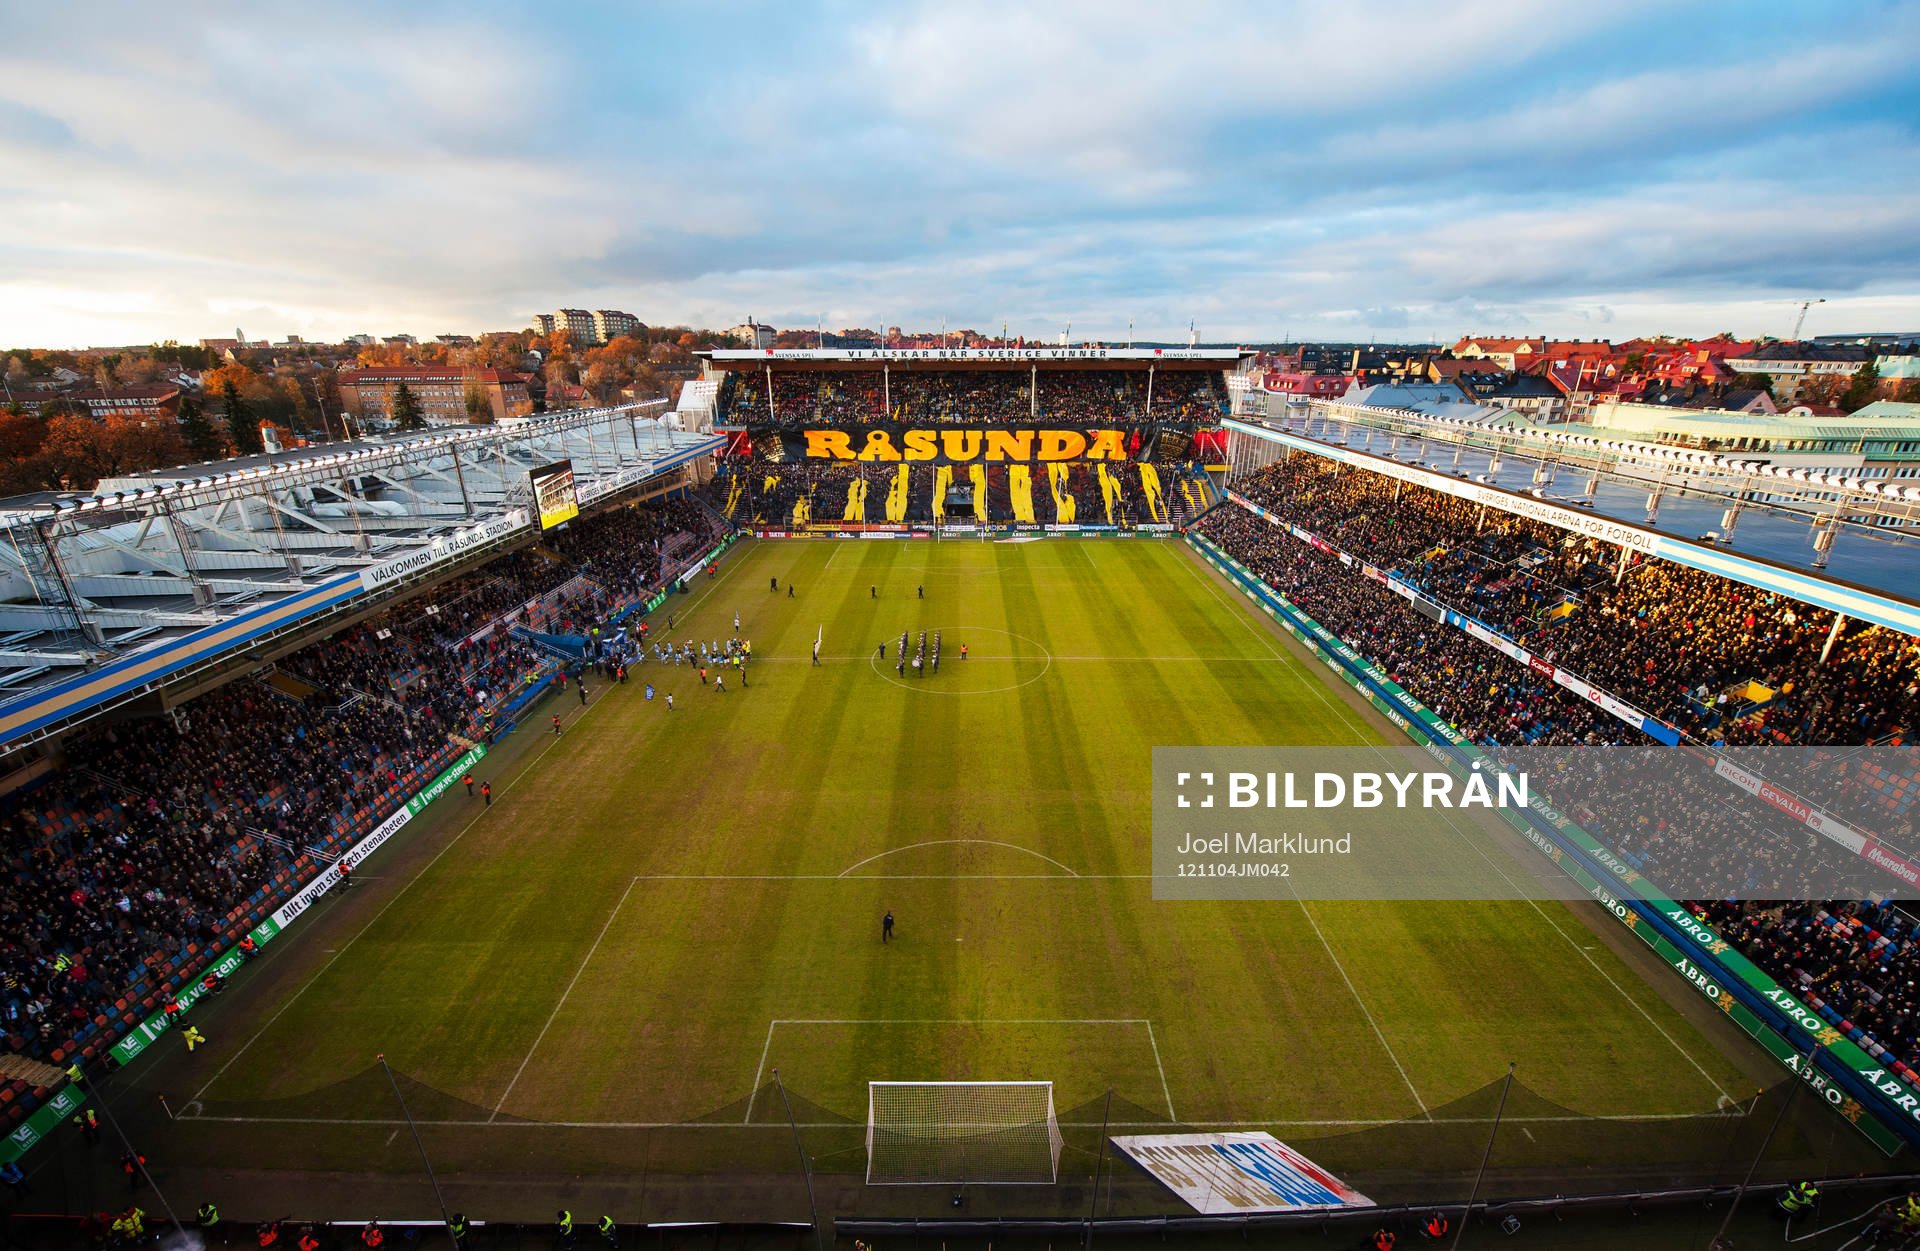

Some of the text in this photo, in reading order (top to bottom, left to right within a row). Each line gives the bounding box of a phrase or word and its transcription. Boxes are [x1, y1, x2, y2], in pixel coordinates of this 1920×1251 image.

[847, 349, 1107, 358] VI ÄLSKAR NÄR SVERIGE VINNER
[803, 429, 1127, 461] RÅSUNDA
[1477, 489, 1652, 550] SVERIGES NATIONALARENA FÖR FOTBOLL
[371, 519, 514, 583] VÄLKOMMEN TILL RÅSUNDA STADION
[1531, 657, 1643, 725] Scandic ICA INTERSPORT
[424, 757, 473, 800] www.ve-sten.se
[1720, 764, 1918, 883] RICOH GEVALIA SVENSKA SPEL Marabou
[282, 899, 302, 921] Allt
[300, 881, 326, 905] inom
[325, 868, 342, 885] ste
[361, 813, 407, 854] stenarbeten
[1431, 720, 1456, 740] ÅBRO
[1589, 847, 1627, 874] ÅBRO
[1666, 909, 1713, 943] ÅBRO
[1762, 989, 1821, 1031] ÅBRO
[257, 923, 270, 936] VE
[1426, 741, 1445, 761] ÅBRO
[1525, 827, 1553, 854] ÅBRO
[1591, 885, 1626, 917] ÅBRO
[1675, 958, 1719, 998] ÅBRO
[1784, 1053, 1842, 1104] ÅBRO
[121, 1036, 137, 1050] VE
[50, 1094, 69, 1109] VE
[12, 1125, 33, 1141] VE
